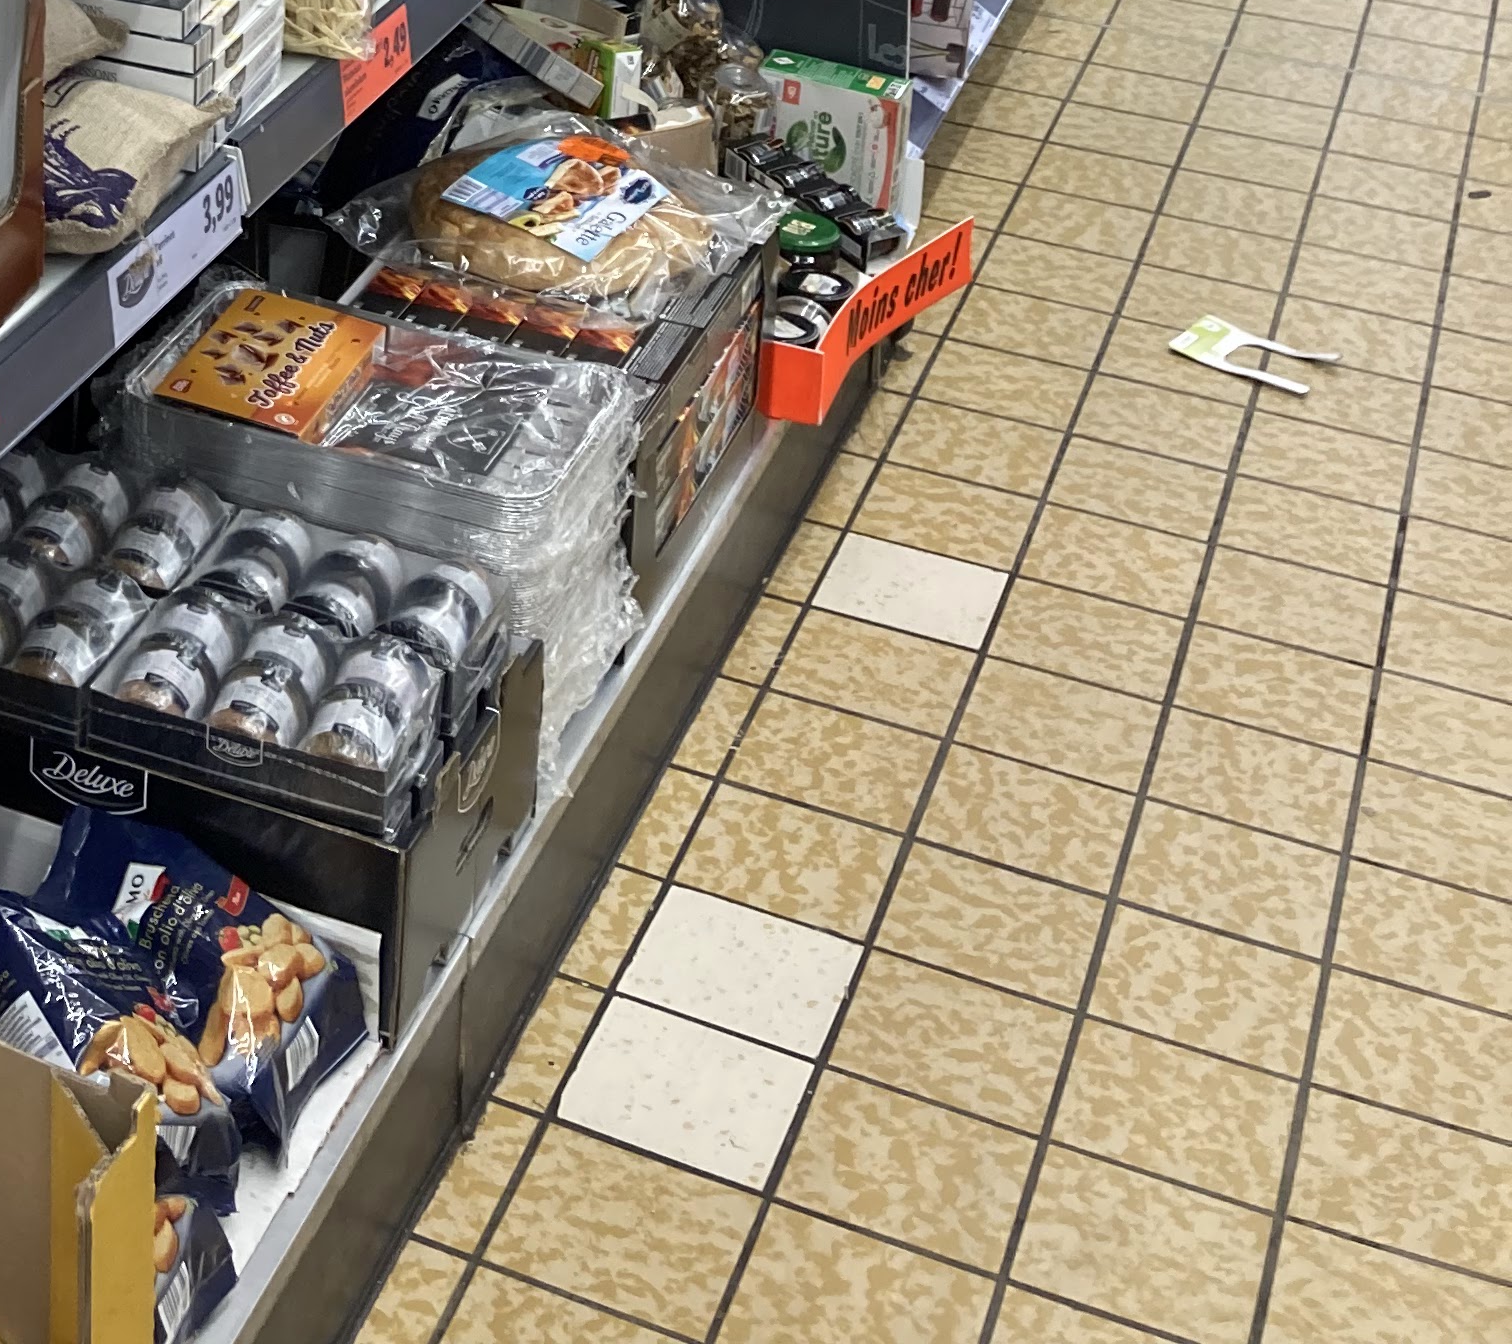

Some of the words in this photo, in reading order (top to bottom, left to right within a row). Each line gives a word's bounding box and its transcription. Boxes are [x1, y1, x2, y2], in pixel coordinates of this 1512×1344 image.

[202, 173, 235, 236] 3,99
[846, 279, 899, 358] Moins
[42, 748, 137, 798] Deluxe
